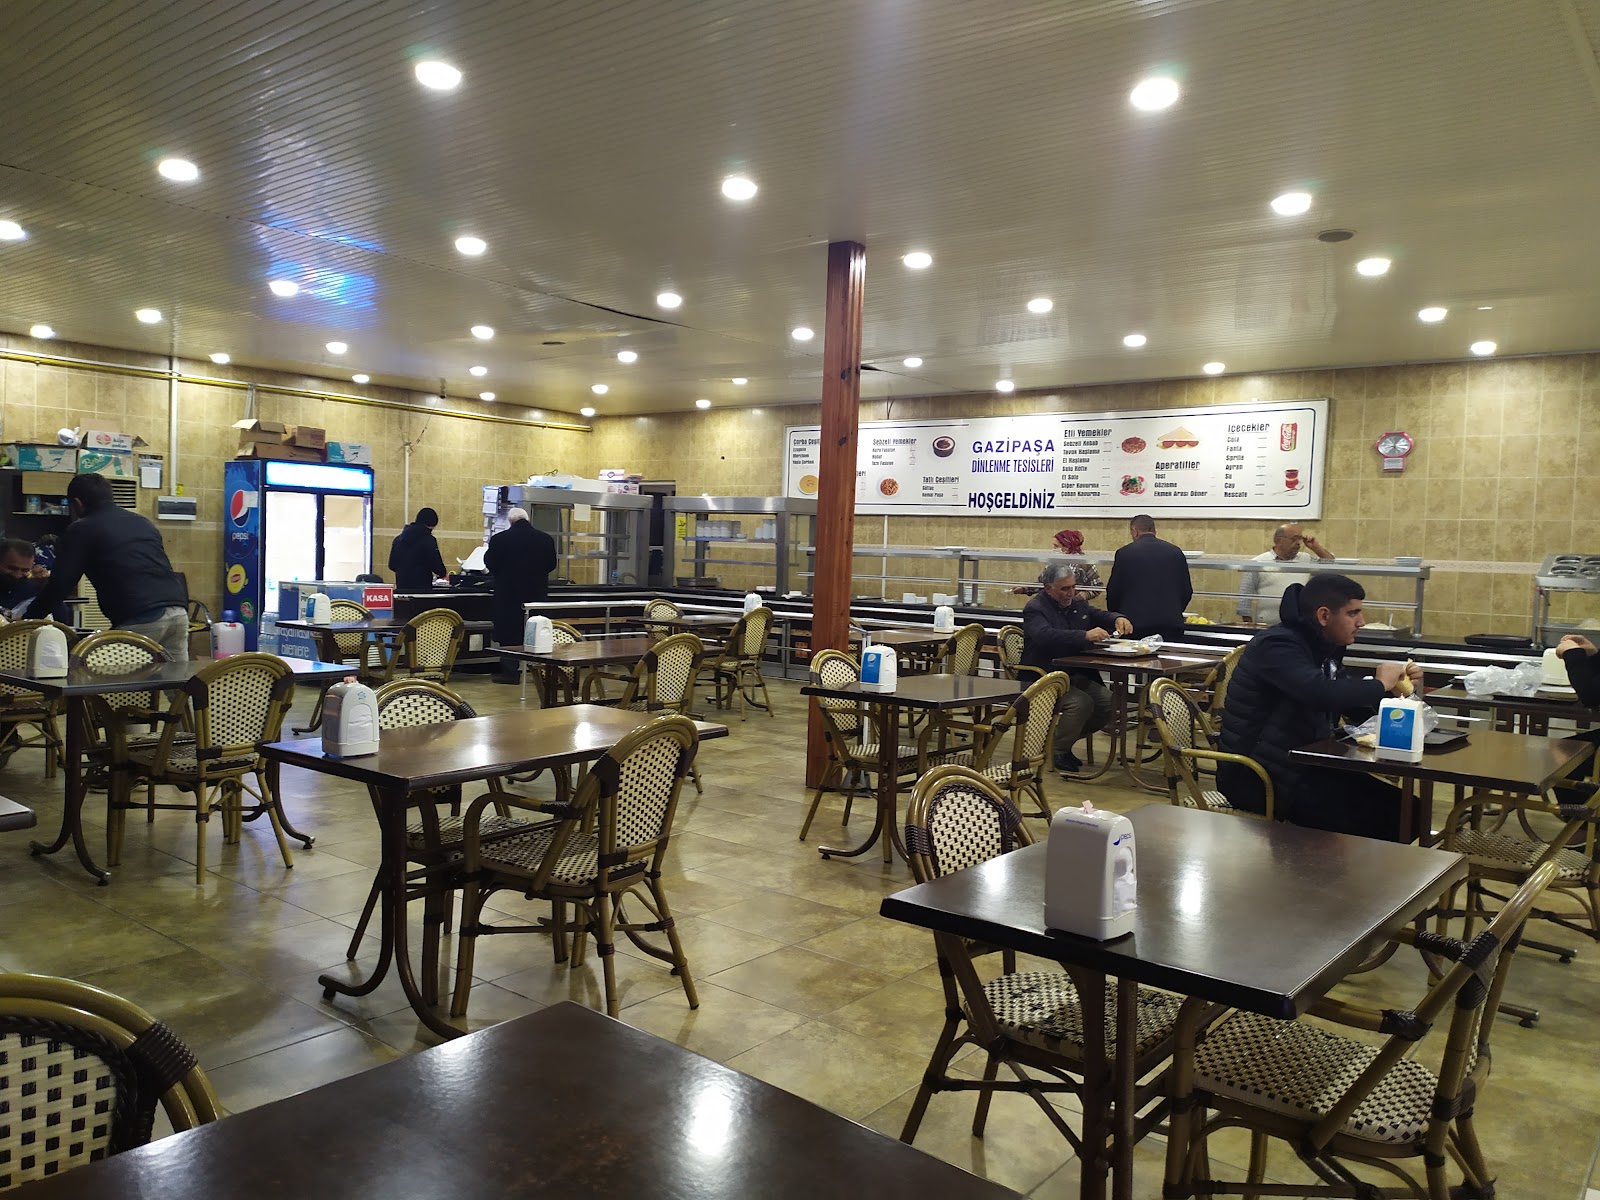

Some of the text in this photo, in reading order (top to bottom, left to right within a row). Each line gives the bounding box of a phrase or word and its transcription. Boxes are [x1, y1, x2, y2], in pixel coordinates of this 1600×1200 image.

[1064, 428, 1112, 438] Etli Yemekler
[972, 437, 1055, 456] GAZİPAŞA
[971, 457, 1055, 473] DİNLENME TESİSLERİ
[1155, 461, 1201, 471] Aperatifler
[968, 489, 1055, 512] HOŞGELDİNİZ
[232, 531, 249, 542] pepsi
